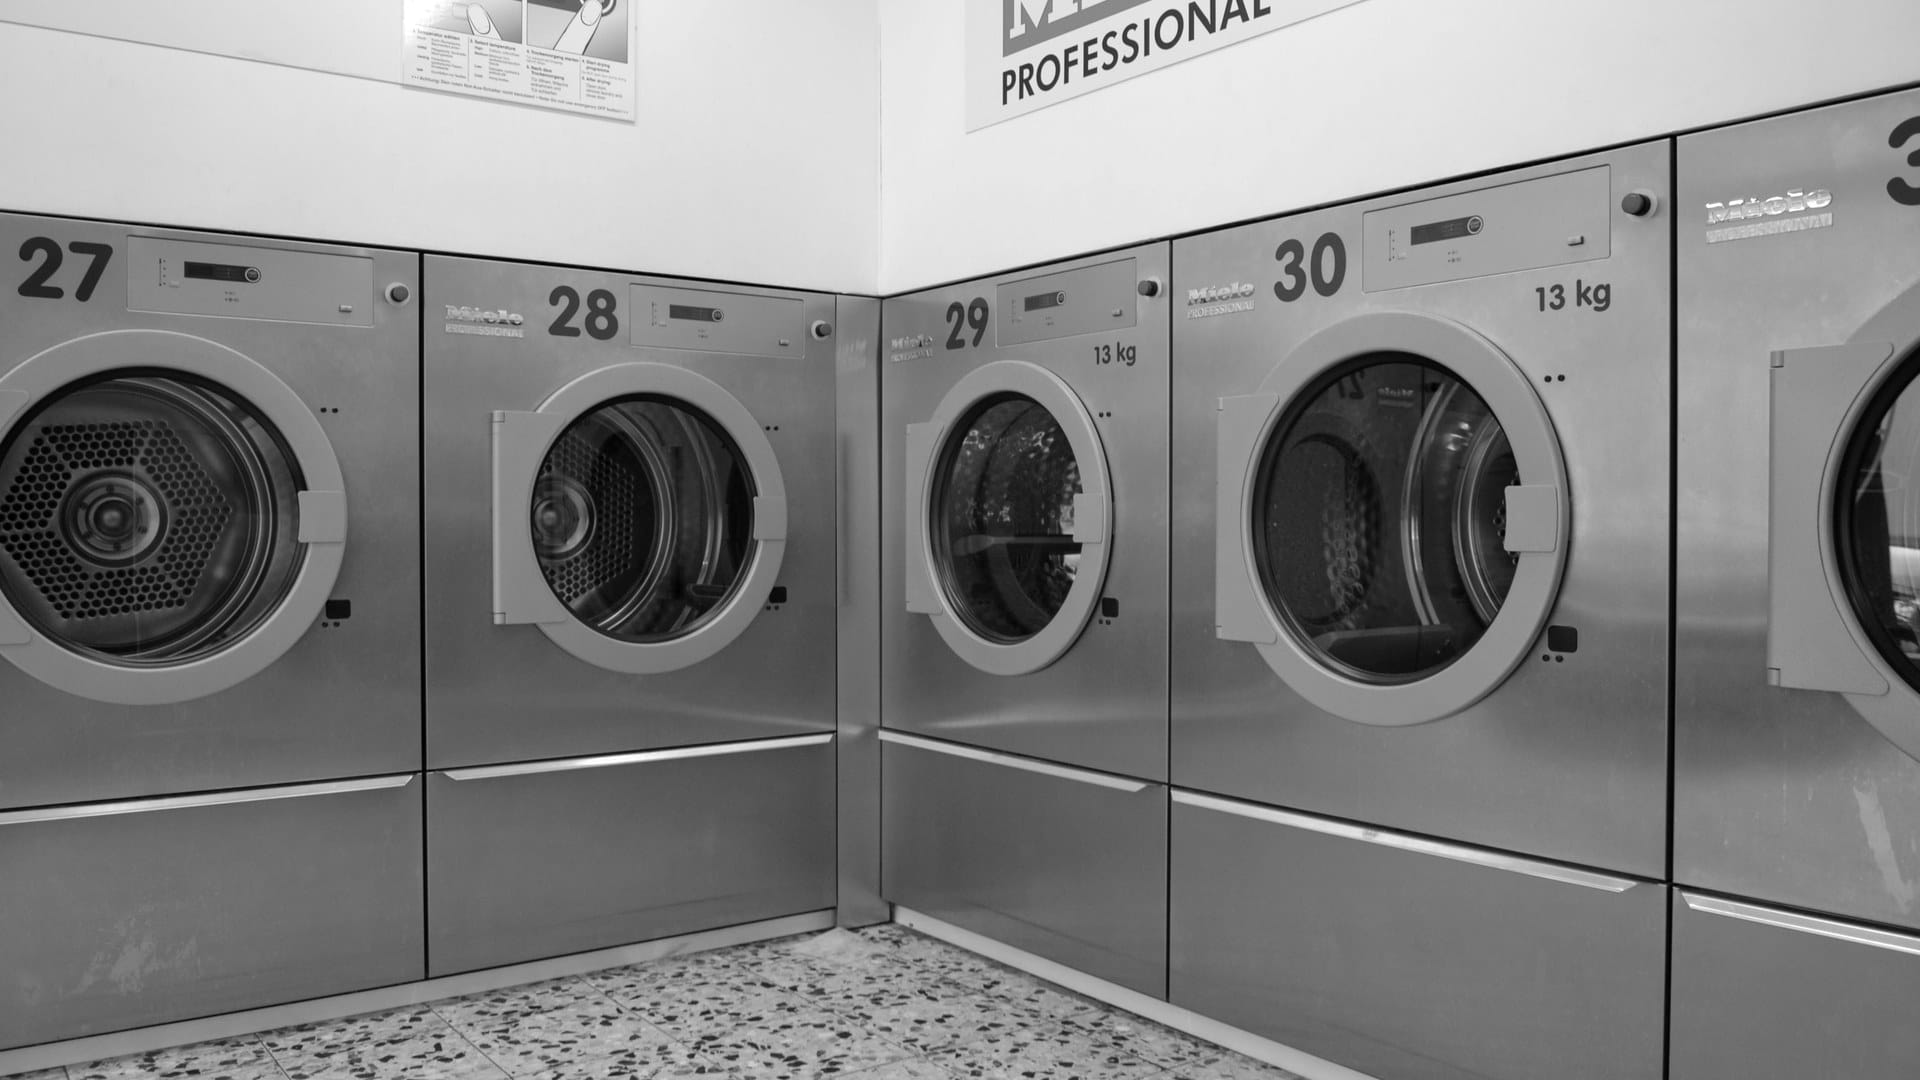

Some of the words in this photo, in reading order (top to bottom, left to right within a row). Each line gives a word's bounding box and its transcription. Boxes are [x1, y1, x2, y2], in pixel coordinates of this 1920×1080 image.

[1706, 188, 1832, 224] Miele
[17, 236, 114, 303] 27
[1273, 232, 1347, 303] 30
[1187, 281, 1256, 306] Miele
[1535, 284, 1566, 312] 13
[1576, 279, 1611, 312] kg
[445, 304, 524, 326] Miele
[548, 285, 619, 341] 28
[945, 297, 989, 351] 29
[1094, 344, 1111, 365] 13
[1116, 341, 1136, 367] kg
